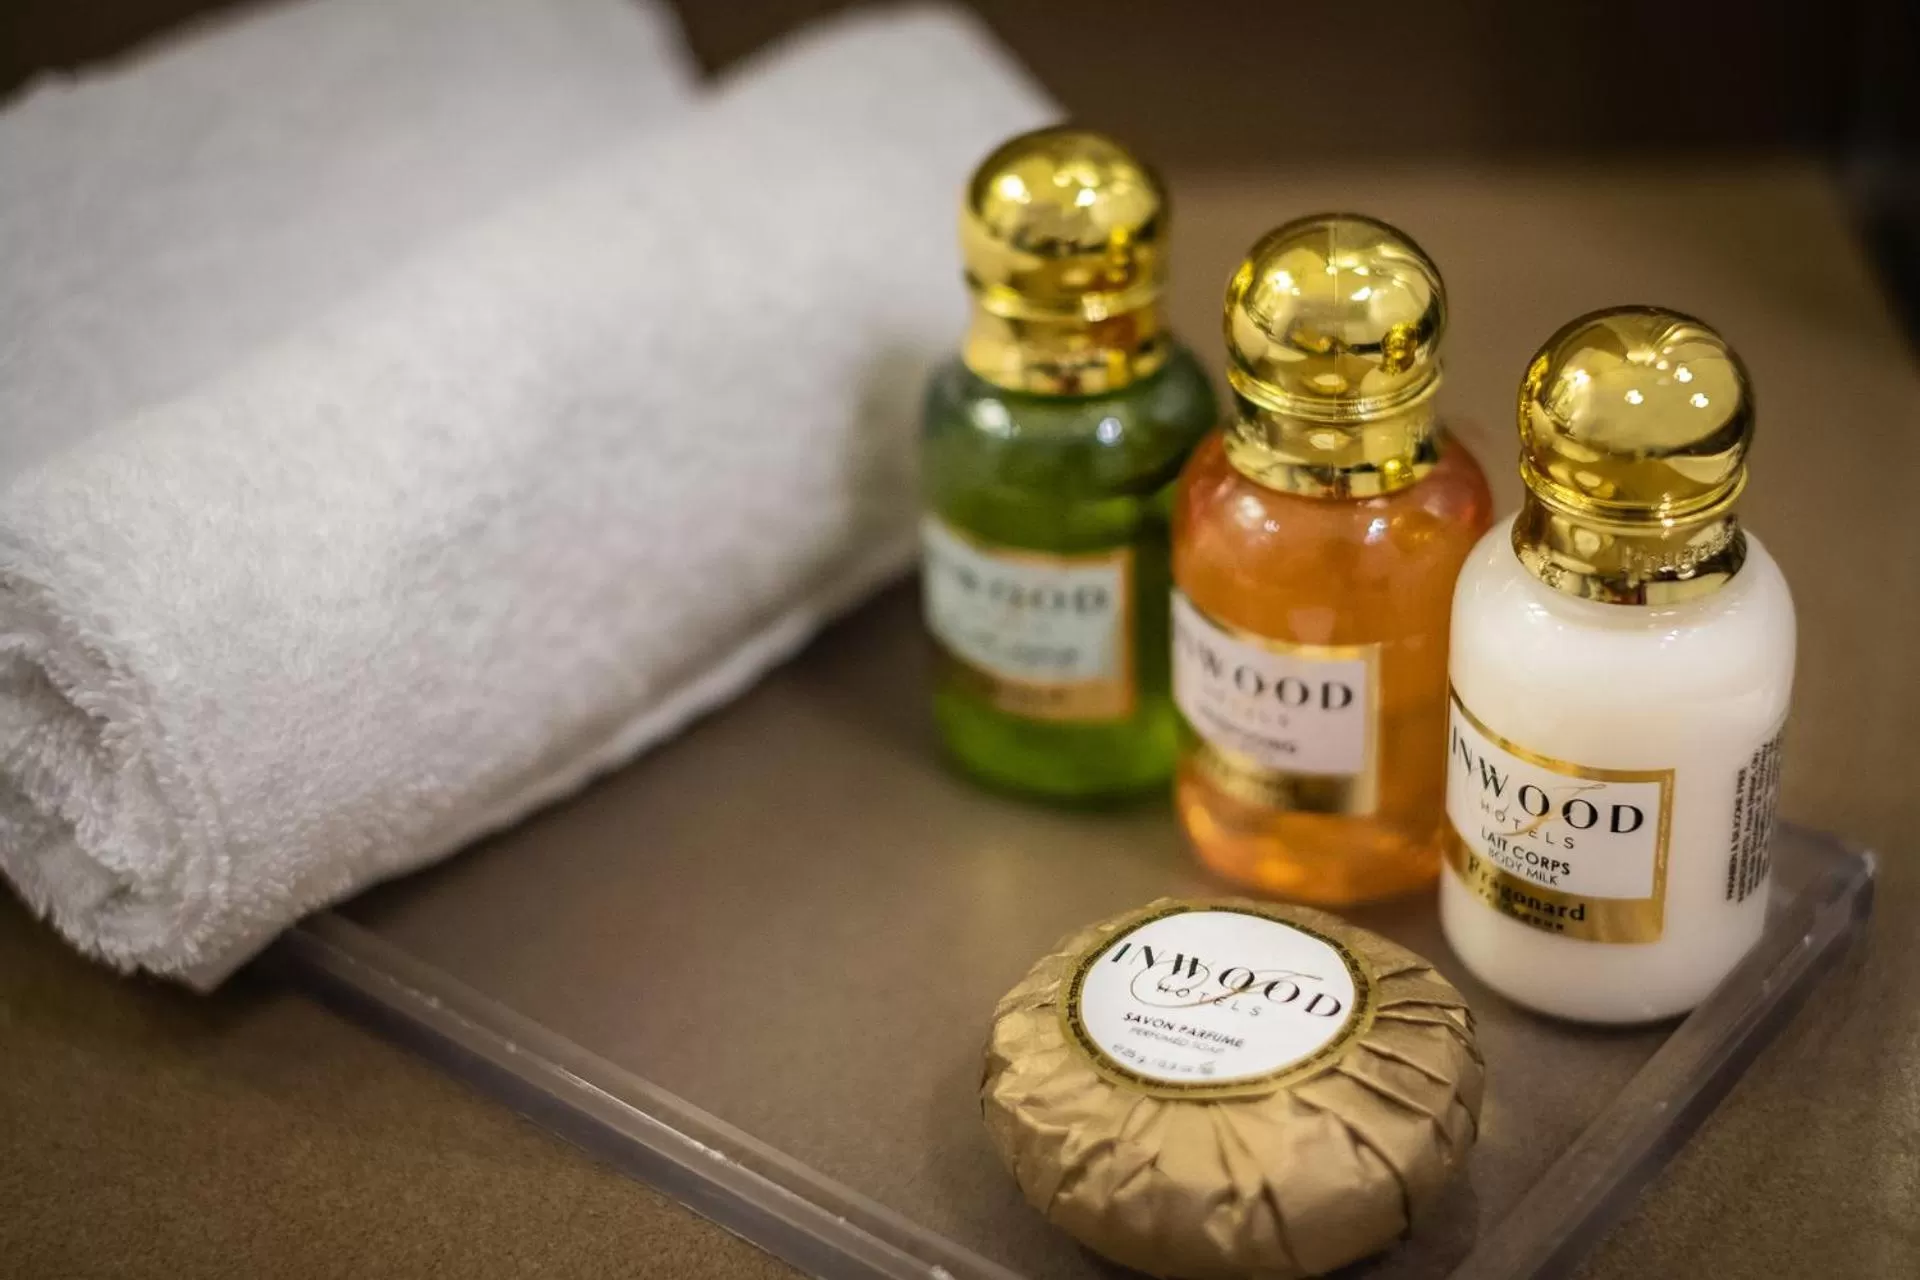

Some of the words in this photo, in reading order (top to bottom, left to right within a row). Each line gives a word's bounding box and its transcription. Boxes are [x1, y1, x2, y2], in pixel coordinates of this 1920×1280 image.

[1452, 725, 1645, 834] INWOOD
[1480, 799, 1575, 850] HOTELS
[1481, 826, 1508, 852] LAIT
[1512, 845, 1571, 876] CORPS
[1526, 867, 1559, 886] MILK
[1111, 942, 1342, 1018] INWOOD
[1123, 1011, 1176, 1031] SAVON
